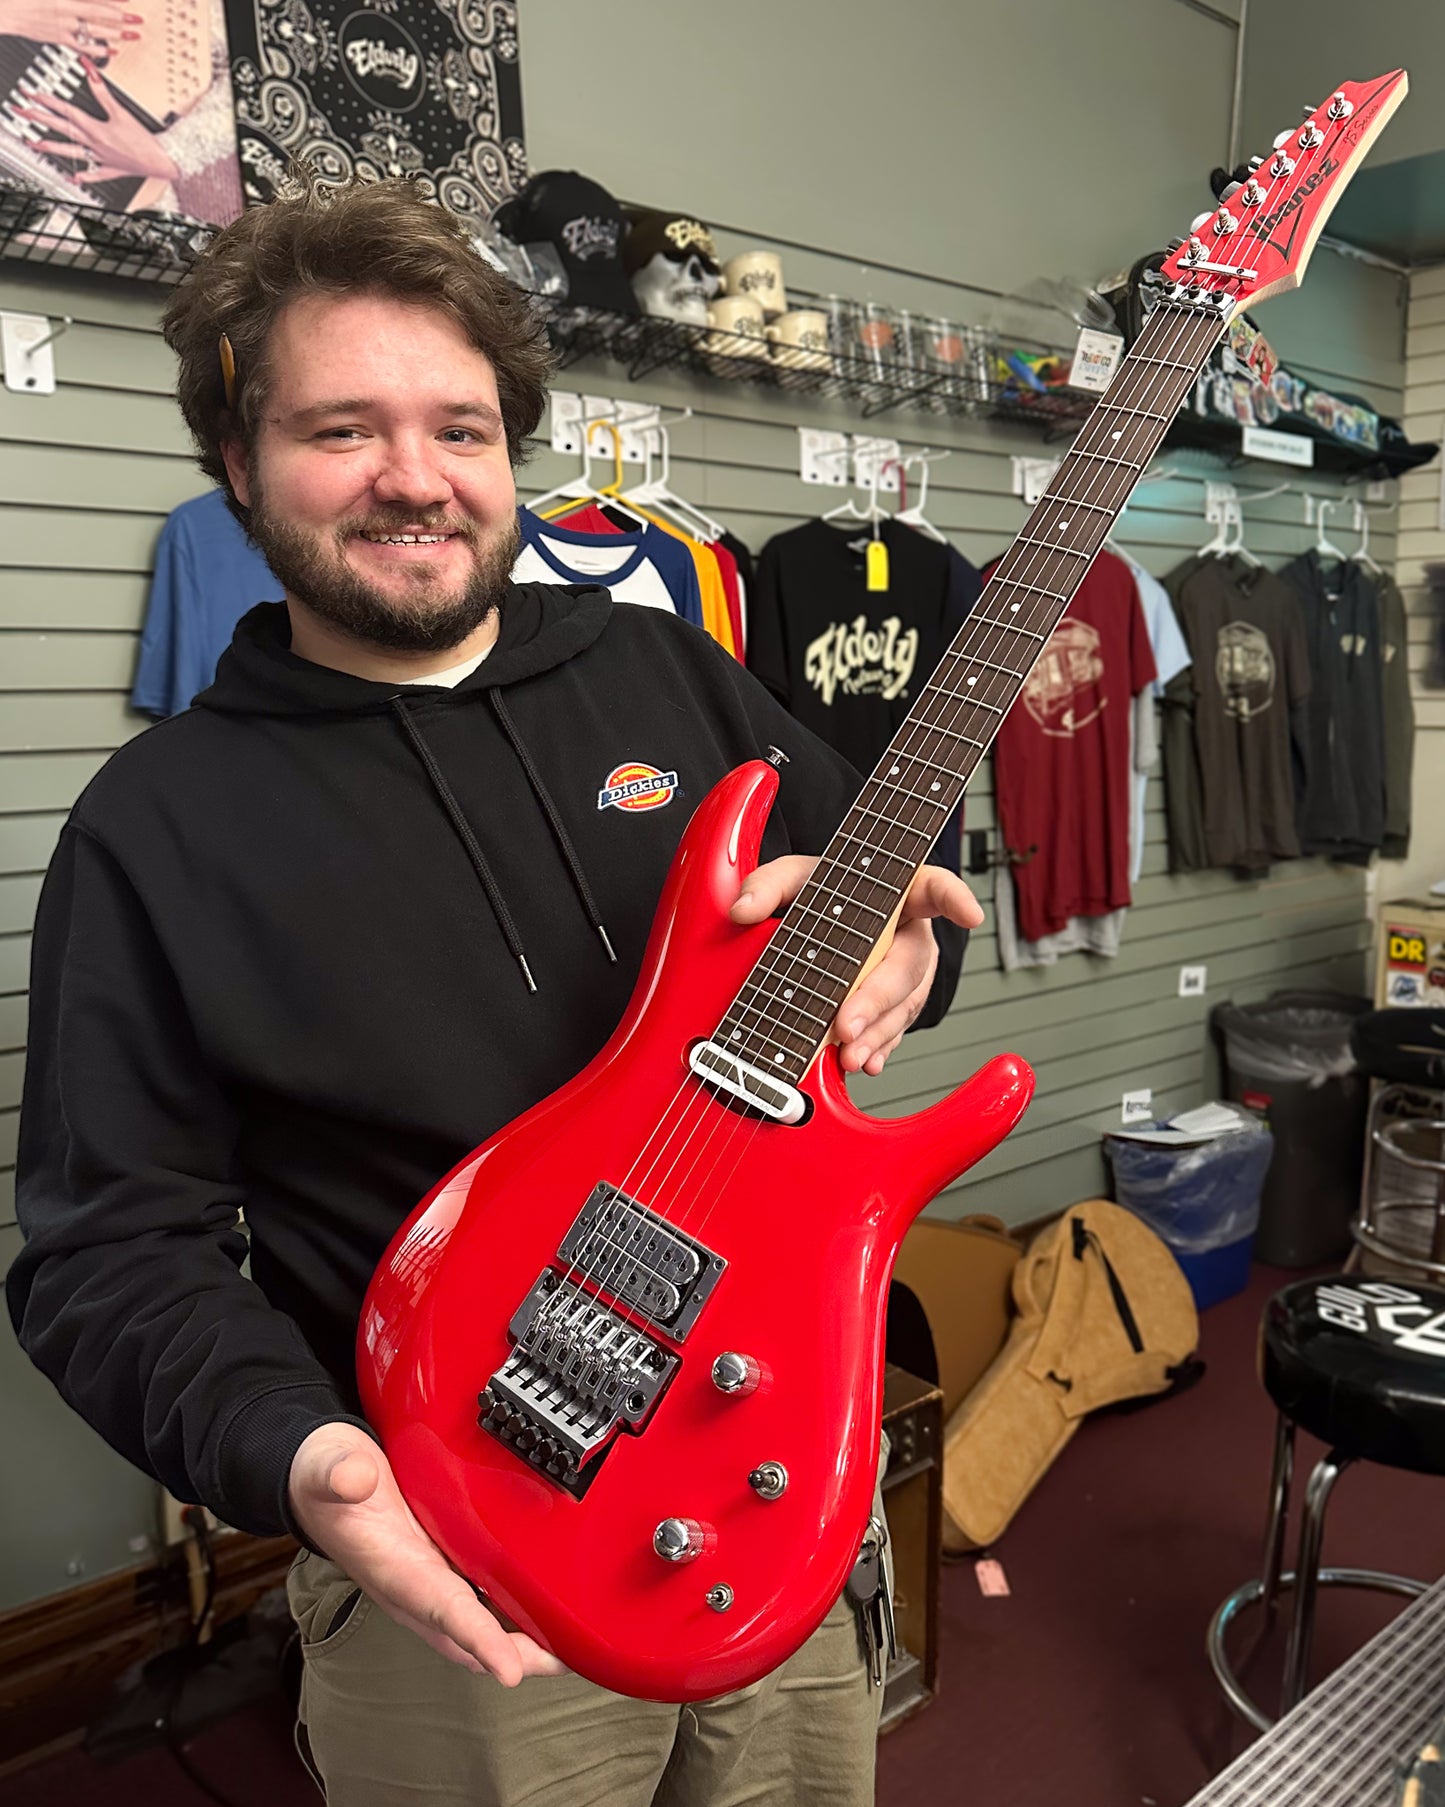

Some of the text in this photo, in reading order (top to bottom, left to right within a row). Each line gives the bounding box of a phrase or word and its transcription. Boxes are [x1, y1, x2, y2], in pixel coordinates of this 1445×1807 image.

[1246, 157, 1340, 243] Ibanez
[608, 776, 671, 802] Dickies
[1390, 937, 1425, 963] DR
[1315, 1282, 1422, 1333] GUILD
